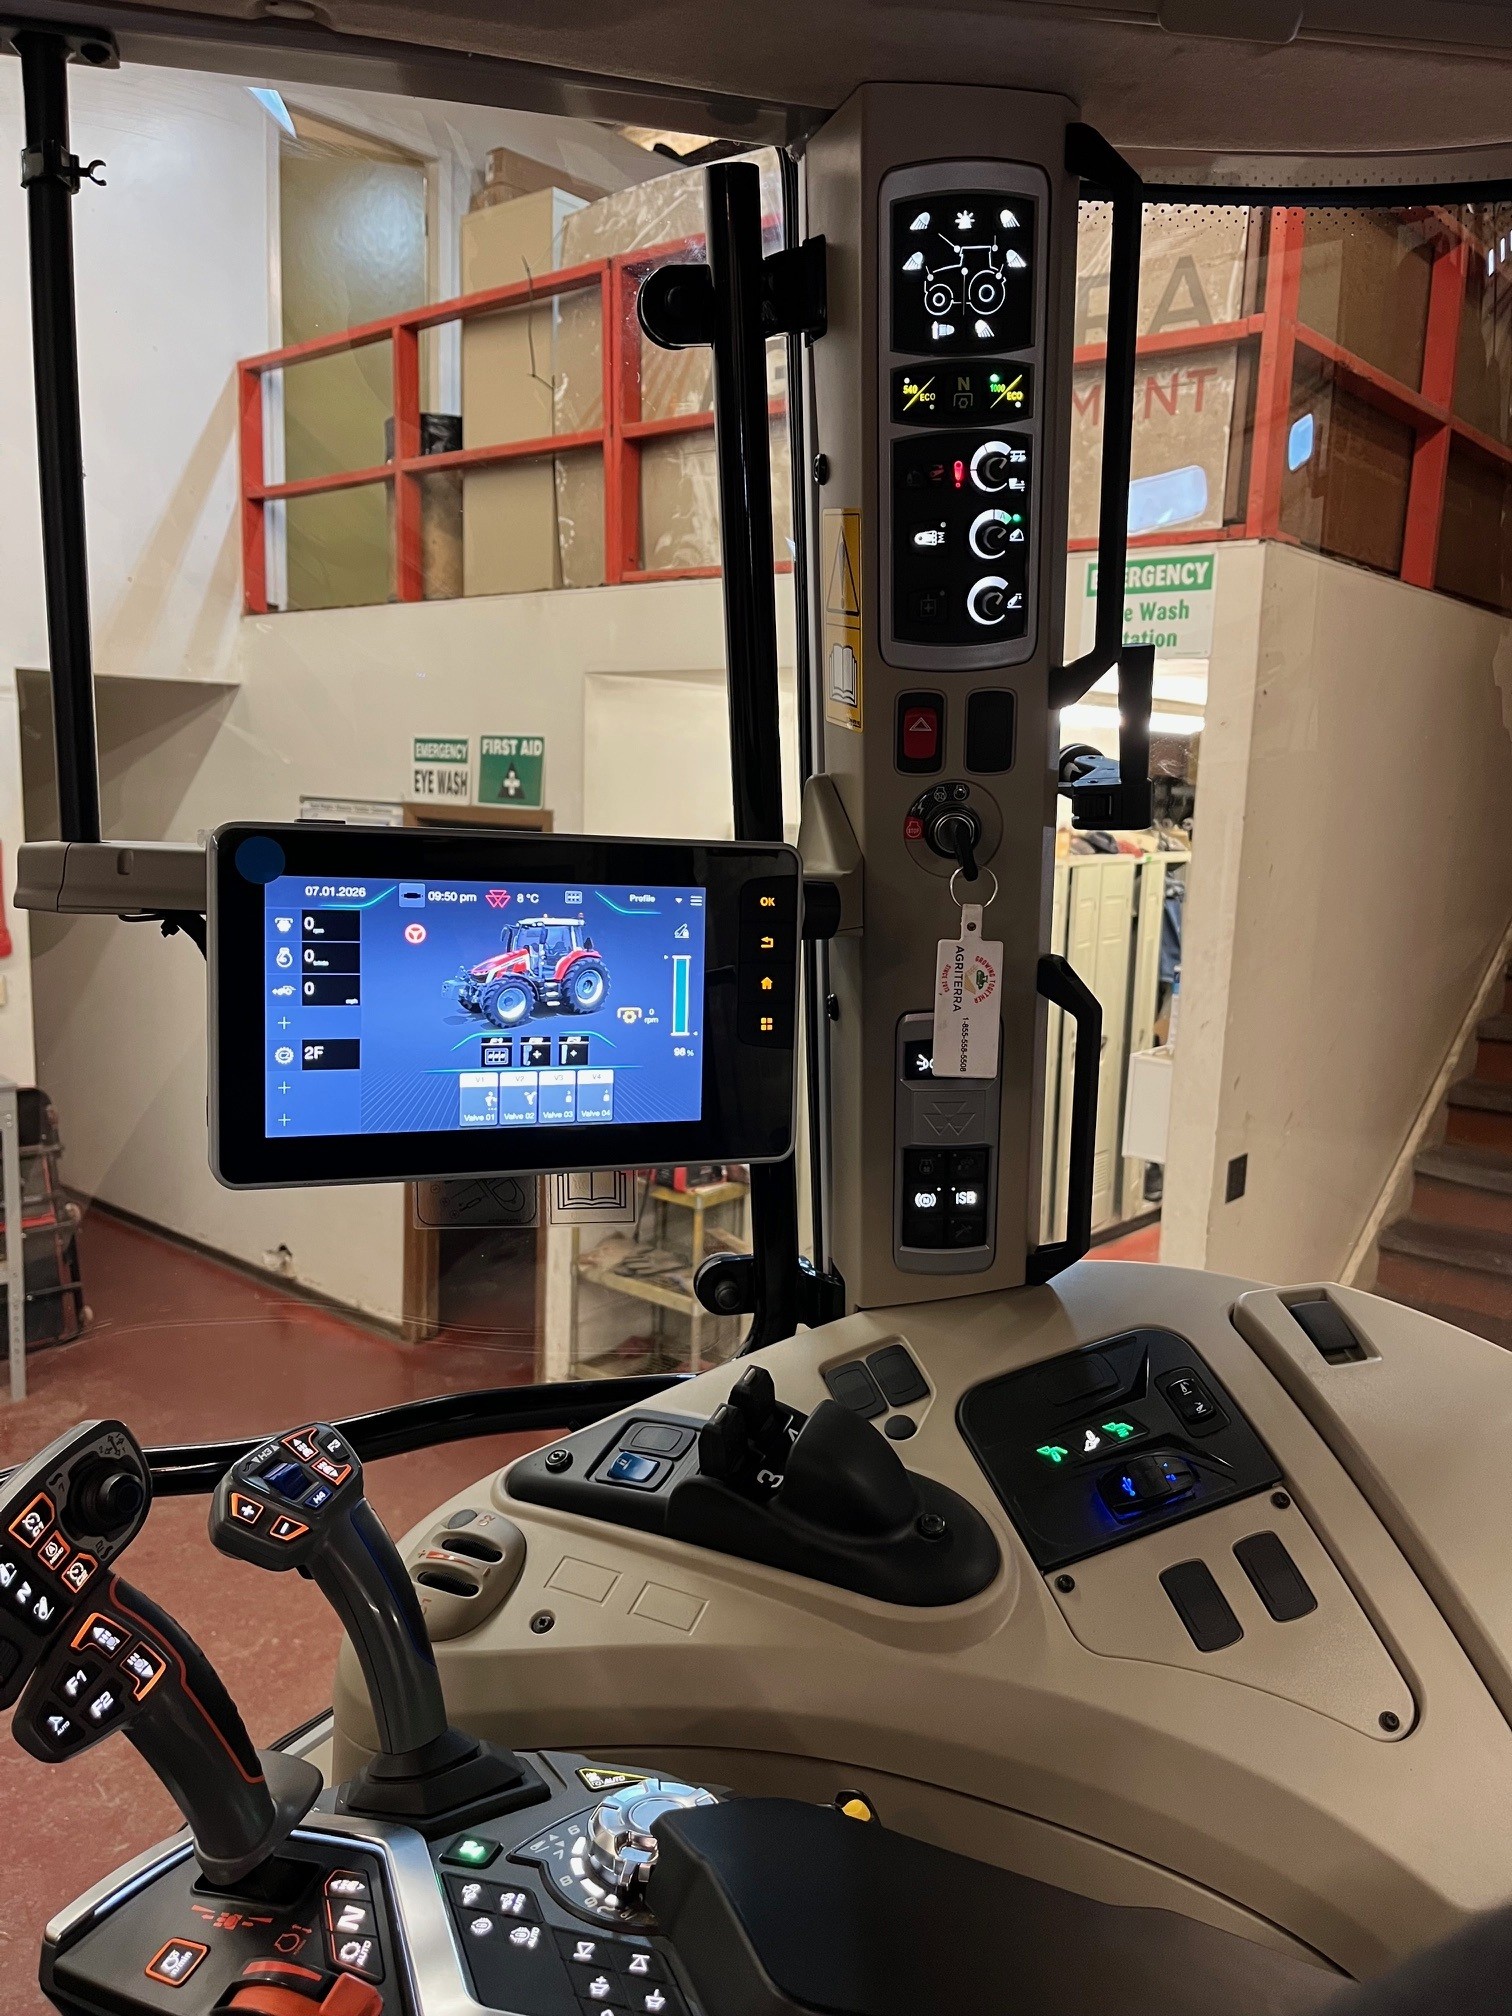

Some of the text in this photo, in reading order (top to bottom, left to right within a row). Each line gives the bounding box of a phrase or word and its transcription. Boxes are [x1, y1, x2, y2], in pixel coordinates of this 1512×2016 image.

[957, 376, 970, 391] N
[903, 384, 936, 402] 540 ECO
[989, 383, 1024, 401] 1000 ECO
[1090, 561, 1210, 591] ERGENCY
[1139, 598, 1190, 622] Wash
[1123, 629, 1178, 648] tation
[414, 741, 468, 761] EMERGENCY
[481, 738, 544, 757] FIRST AID
[414, 769, 468, 796] EYE WASH
[304, 885, 367, 898] 07.01.2026
[427, 890, 478, 904] 09:50 pm
[516, 893, 540, 904] 8 °C
[629, 893, 656, 903] Profile
[759, 896, 776, 907] OK
[303, 916, 315, 931] 0
[303, 949, 315, 963] 0
[952, 945, 965, 1013] AGRITERRA
[303, 981, 315, 996] 0
[973, 979, 996, 1004] TOGETHER
[648, 1008, 655, 1016] 0
[643, 1016, 660, 1025] rpm
[304, 1045, 325, 1061] 2F
[686, 1049, 695, 1057] %
[463, 1113, 496, 1122] Valve 01
[503, 1112, 536, 1121] Valve 02
[542, 1110, 574, 1119] Valve 03
[580, 1108, 611, 1118] Valve 04
[955, 1190, 977, 1206] ISB
[259, 1447, 273, 1461] H3
[756, 1468, 785, 1489] 3
[312, 1490, 326, 1504] H4
[16, 1580, 32, 1605] N
[64, 1669, 88, 1698] F1
[89, 1690, 115, 1720] F2
[56, 1720, 71, 1737] AUTO
[603, 1775, 627, 1786] AUTO
[559, 1874, 574, 1888] 8
[512, 1893, 527, 1915] AUTO
[584, 1896, 599, 1909] 9
[336, 1904, 367, 1934] N
[528, 1925, 541, 1949] AUTO
[357, 1939, 373, 1968] AUTO
